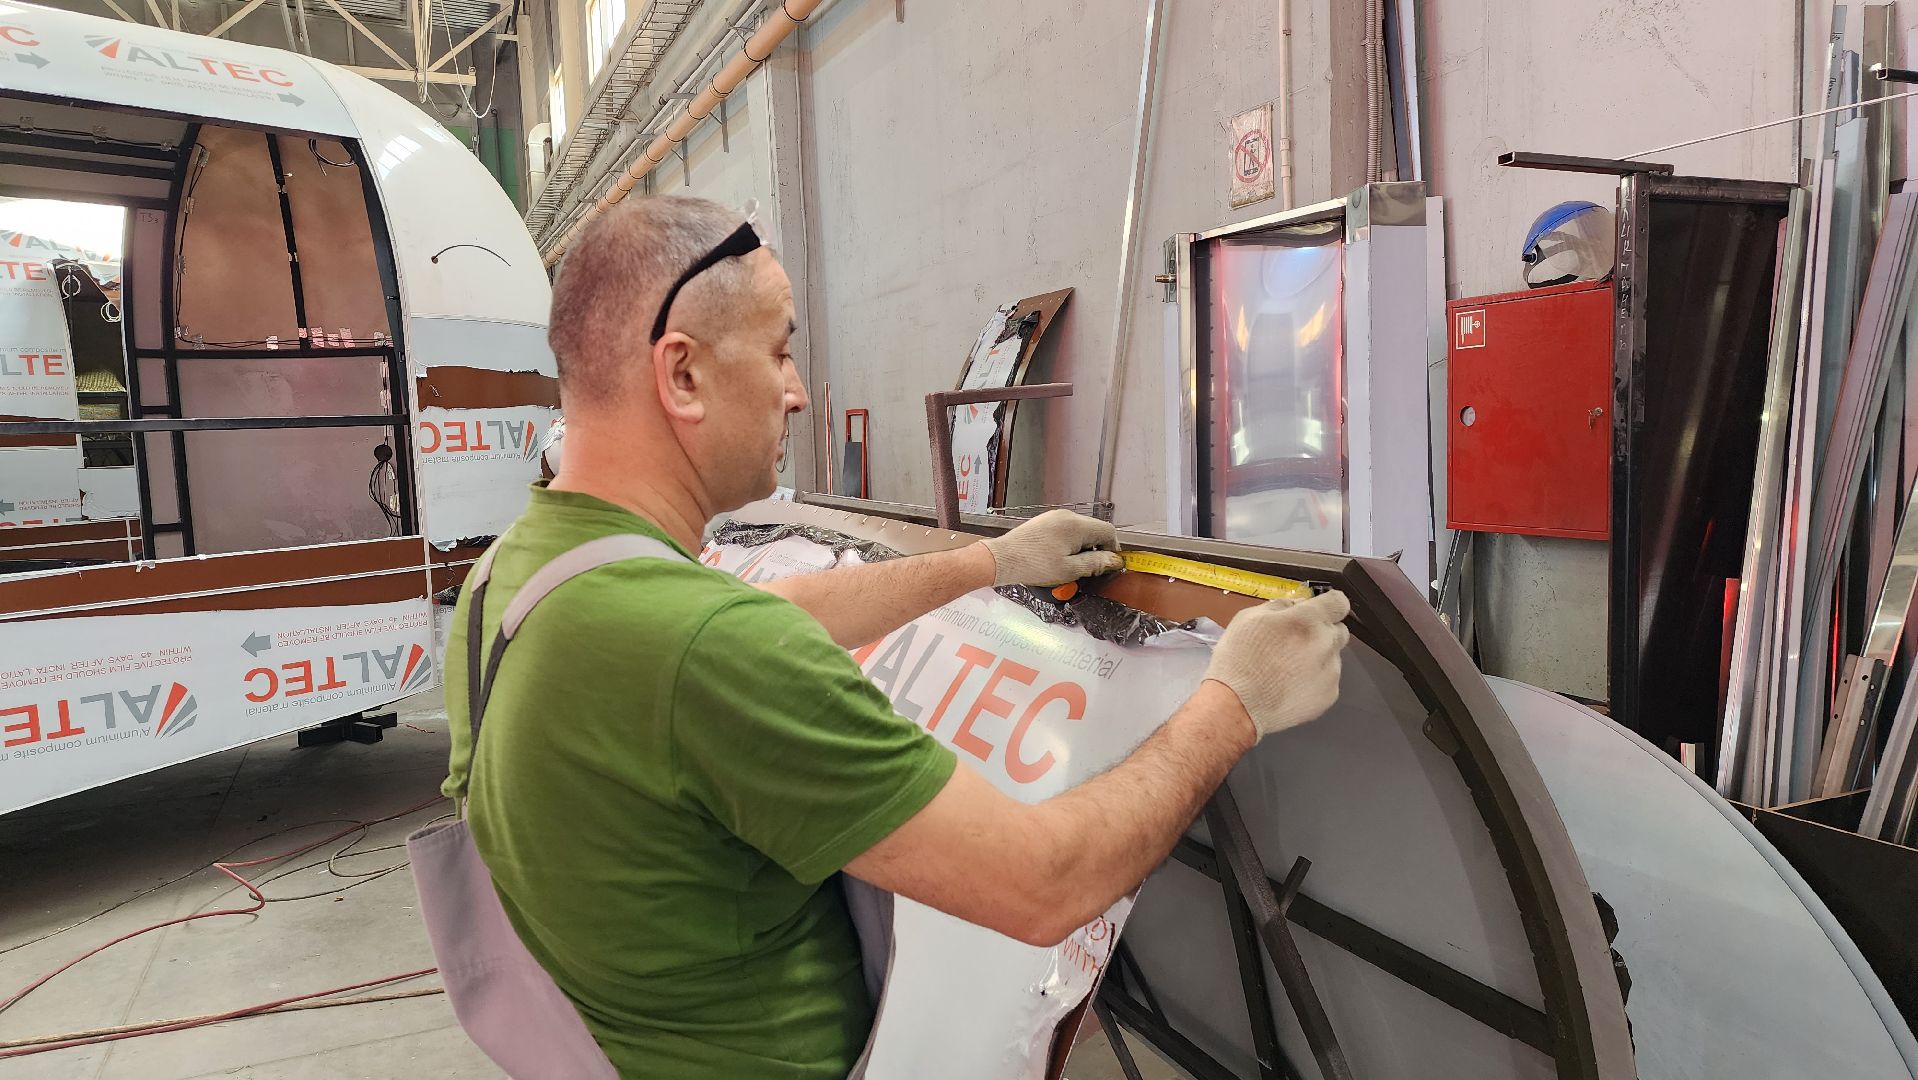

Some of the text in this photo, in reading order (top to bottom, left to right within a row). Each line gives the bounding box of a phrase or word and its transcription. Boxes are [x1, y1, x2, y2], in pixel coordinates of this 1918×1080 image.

[127, 46, 294, 87] ALTEC
[419, 420, 525, 454] ALTEC
[277, 624, 333, 640] INSTALLATION
[336, 620, 361, 631] AFTER
[277, 635, 318, 648] REMOVED
[318, 633, 330, 642] BE
[158, 645, 192, 657] WITHIN
[69, 657, 104, 669] AFTER
[107, 654, 134, 665] DAYS
[133, 654, 193, 671] PROTECTIVE
[1049, 642, 1124, 681] material
[65, 667, 106, 681] SHOULD
[109, 663, 131, 675] FILM
[243, 644, 404, 703] ALTEC
[48, 673, 63, 682] BE
[245, 681, 397, 717] Aluminium composite material
[866, 622, 1088, 785] ALTEC
[0, 684, 162, 748] ALTE
[85, 726, 151, 747] Aluminium
[13, 742, 82, 761] composite
